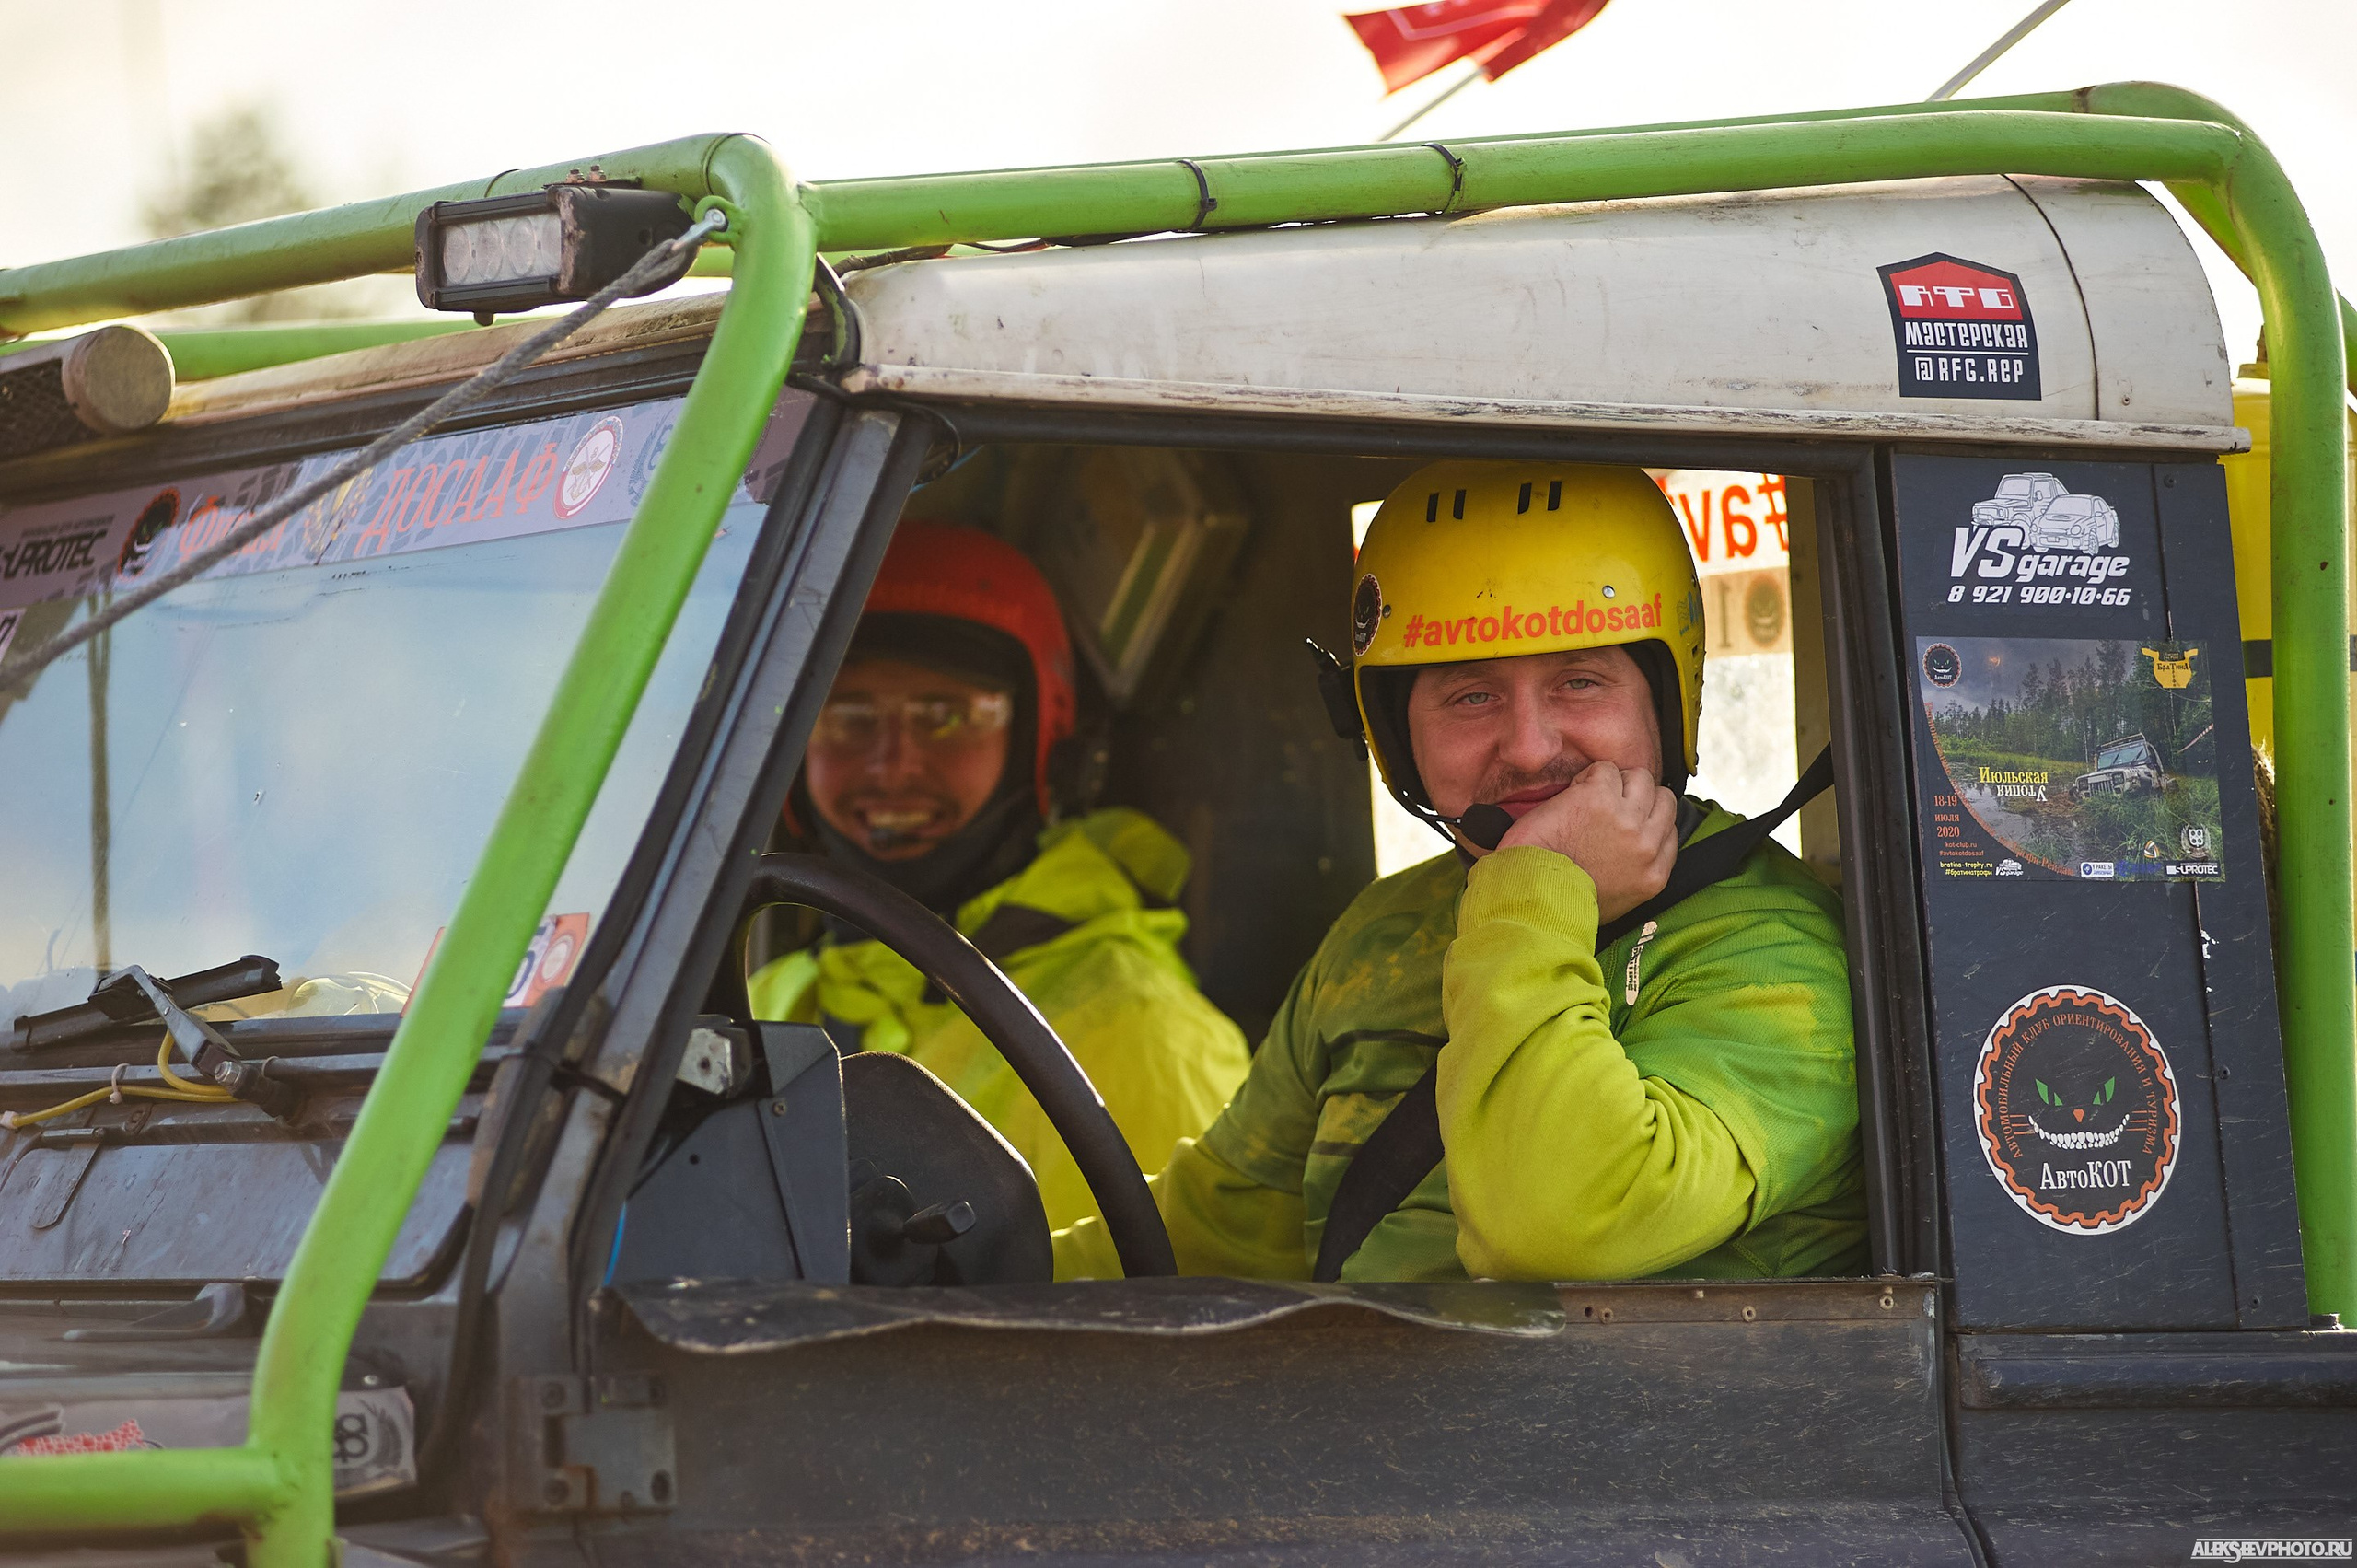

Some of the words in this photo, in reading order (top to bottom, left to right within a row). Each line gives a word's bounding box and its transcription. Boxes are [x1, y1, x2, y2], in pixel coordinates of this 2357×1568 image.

[353, 442, 558, 553] ДОСААФ
[1950, 527, 2025, 578] VS
[2015, 554, 2131, 584] garage
[1947, 585, 1966, 604] 8
[1972, 585, 2013, 604] 921
[1403, 592, 1662, 648] #avtokotdosaaf
[1979, 766, 2049, 784] Июльская
[1996, 784, 2048, 802] Утопия
[1937, 826, 1960, 838] 2020
[2021, 1017, 2050, 1044] КЛУБ
[2052, 1013, 2147, 1074] ОРИЕНТИРОВАНИЯ
[1998, 1040, 2024, 1159] АВТОМОБИЛЬНЫЙ
[2142, 1076, 2153, 1088] И
[2142, 1091, 2157, 1156] ТУРИЗМА
